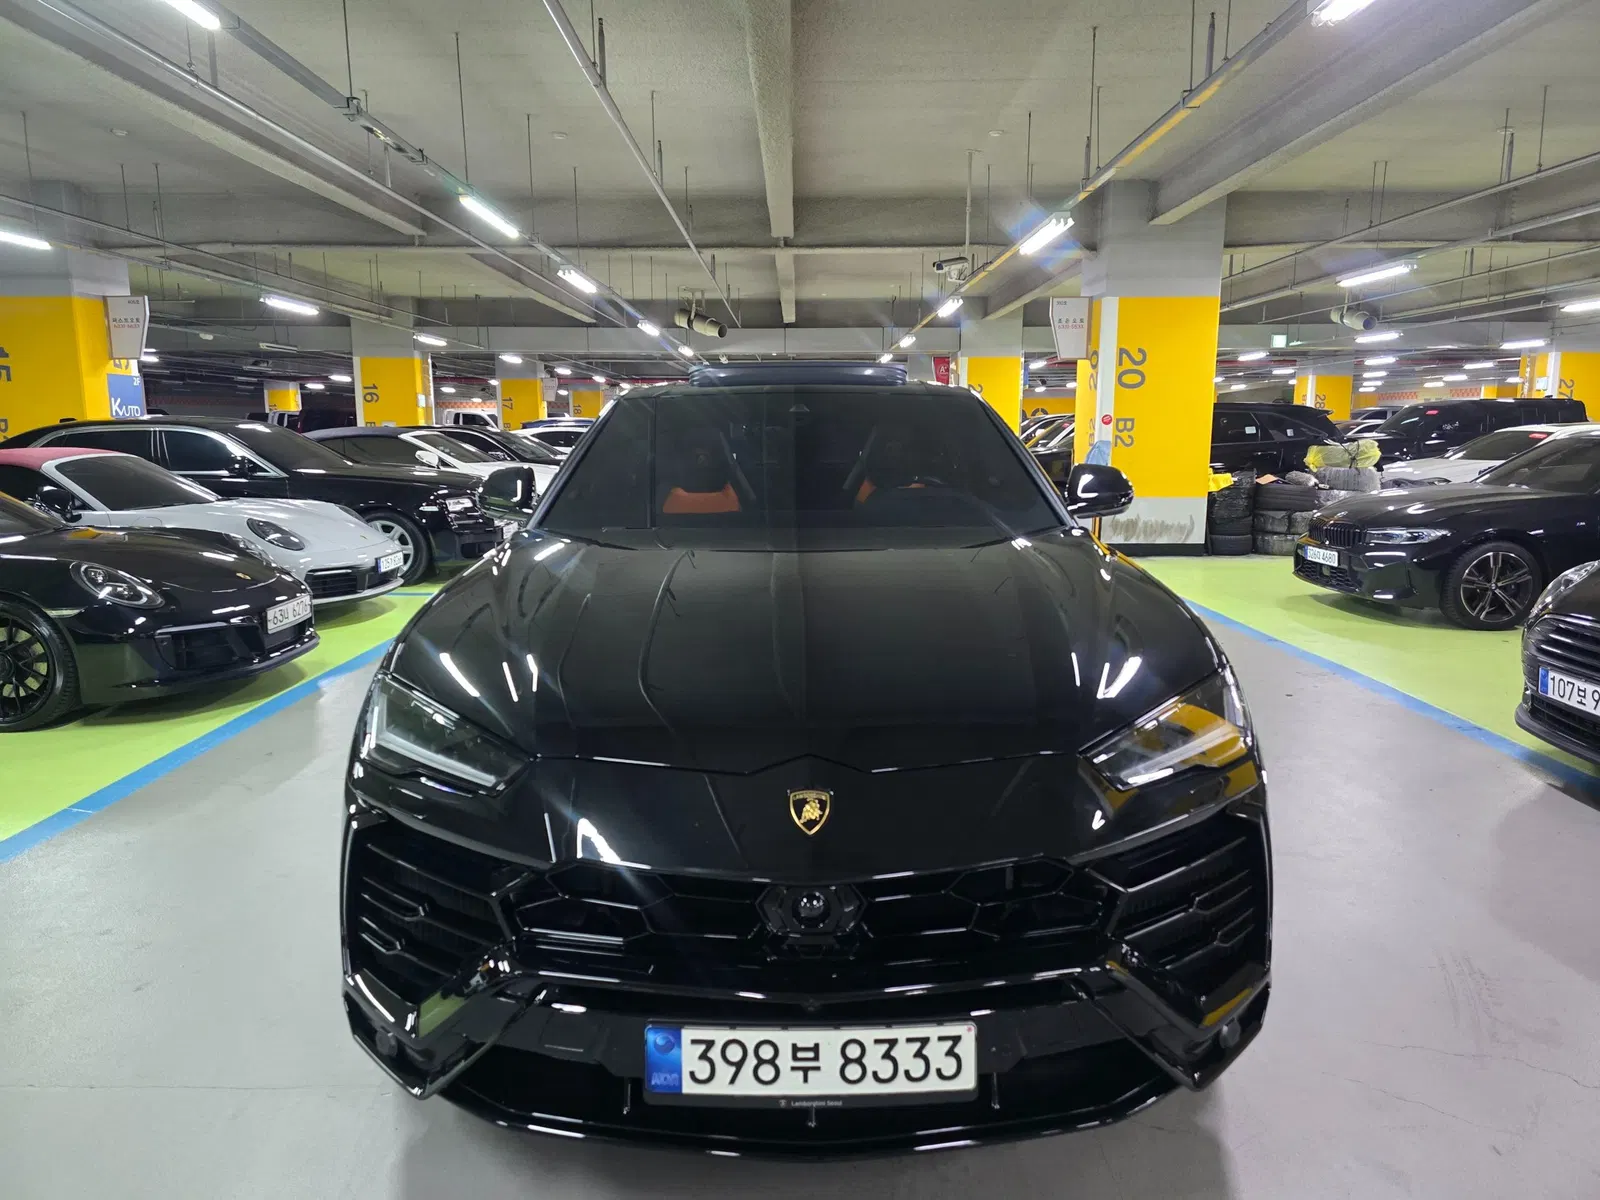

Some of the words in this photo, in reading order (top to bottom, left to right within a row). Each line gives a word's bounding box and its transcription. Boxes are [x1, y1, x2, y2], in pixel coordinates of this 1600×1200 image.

[1117, 347, 1147, 390] 20
[363, 383, 380, 403] 16
[501, 396, 514, 411] 17
[1314, 393, 1327, 409] 28
[1114, 417, 1135, 448] B2
[1550, 675, 1587, 707] 107보
[688, 1038, 822, 1086] 398부
[839, 1034, 963, 1085] 8333
